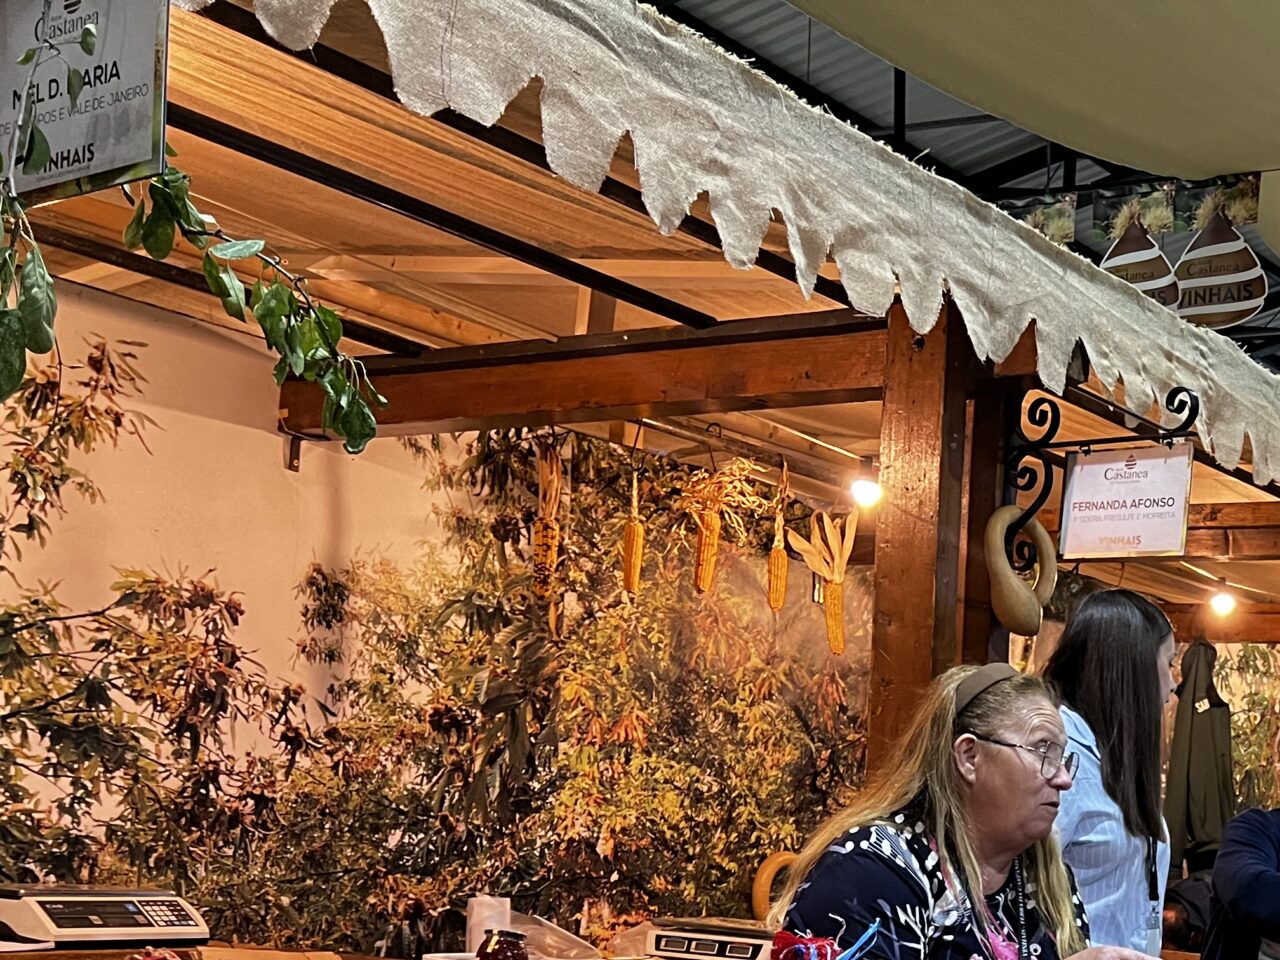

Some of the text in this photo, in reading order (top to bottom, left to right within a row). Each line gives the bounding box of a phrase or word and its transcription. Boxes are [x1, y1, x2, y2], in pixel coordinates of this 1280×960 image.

[35, 11, 99, 41] Castanea
[49, 79, 63, 98] D.
[68, 60, 120, 95] ARIA
[59, 107, 65, 120] E
[92, 97, 105, 110] DE
[107, 83, 149, 105] JANEIRO
[16, 143, 94, 173] NHAIS
[1187, 263, 1240, 277] Castanea
[1104, 468, 1148, 481] Castanea
[1072, 497, 1175, 512] FERNANDA AFONSO
[1098, 535, 1141, 545] VINHAIS
